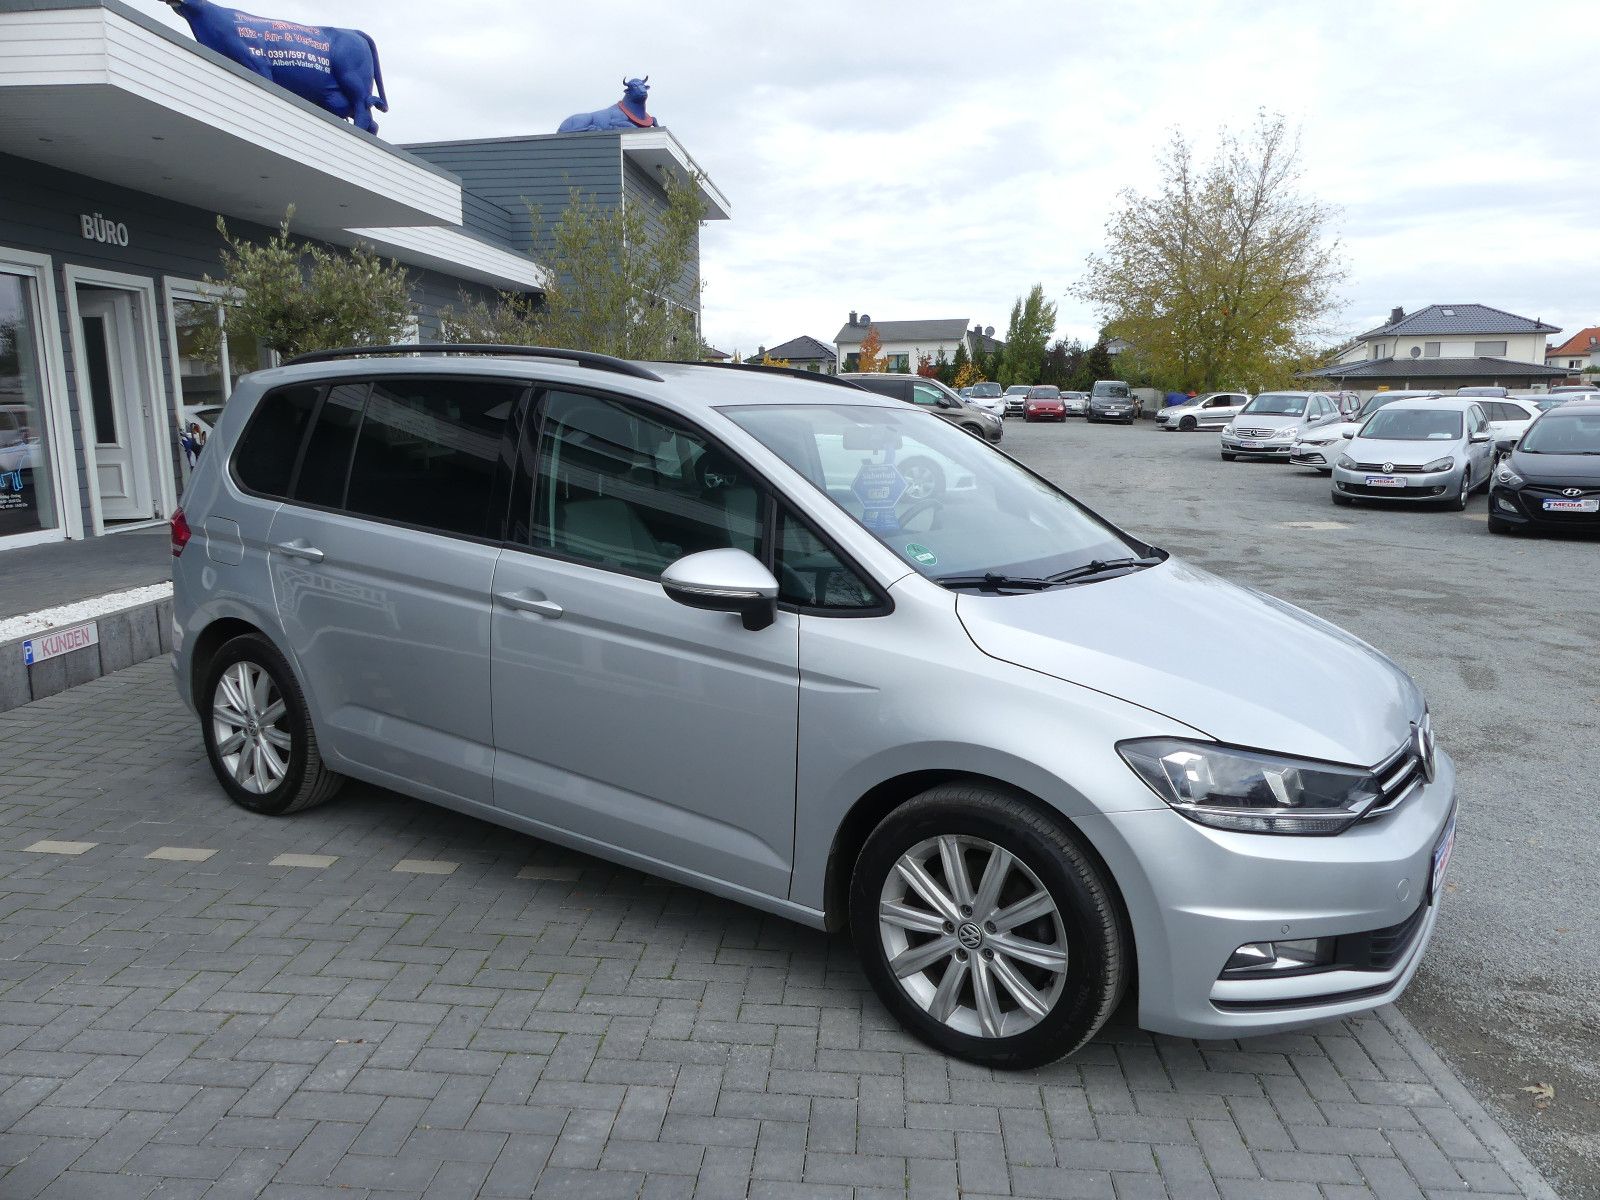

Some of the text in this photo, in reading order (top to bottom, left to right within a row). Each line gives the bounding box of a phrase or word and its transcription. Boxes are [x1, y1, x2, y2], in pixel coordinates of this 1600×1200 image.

[249, 47, 267, 57] Tel.
[268, 50, 306, 60] 0391/597
[317, 56, 330, 67] 100
[80, 212, 129, 247] BÜRO
[24, 626, 90, 660] P KUNDEN
